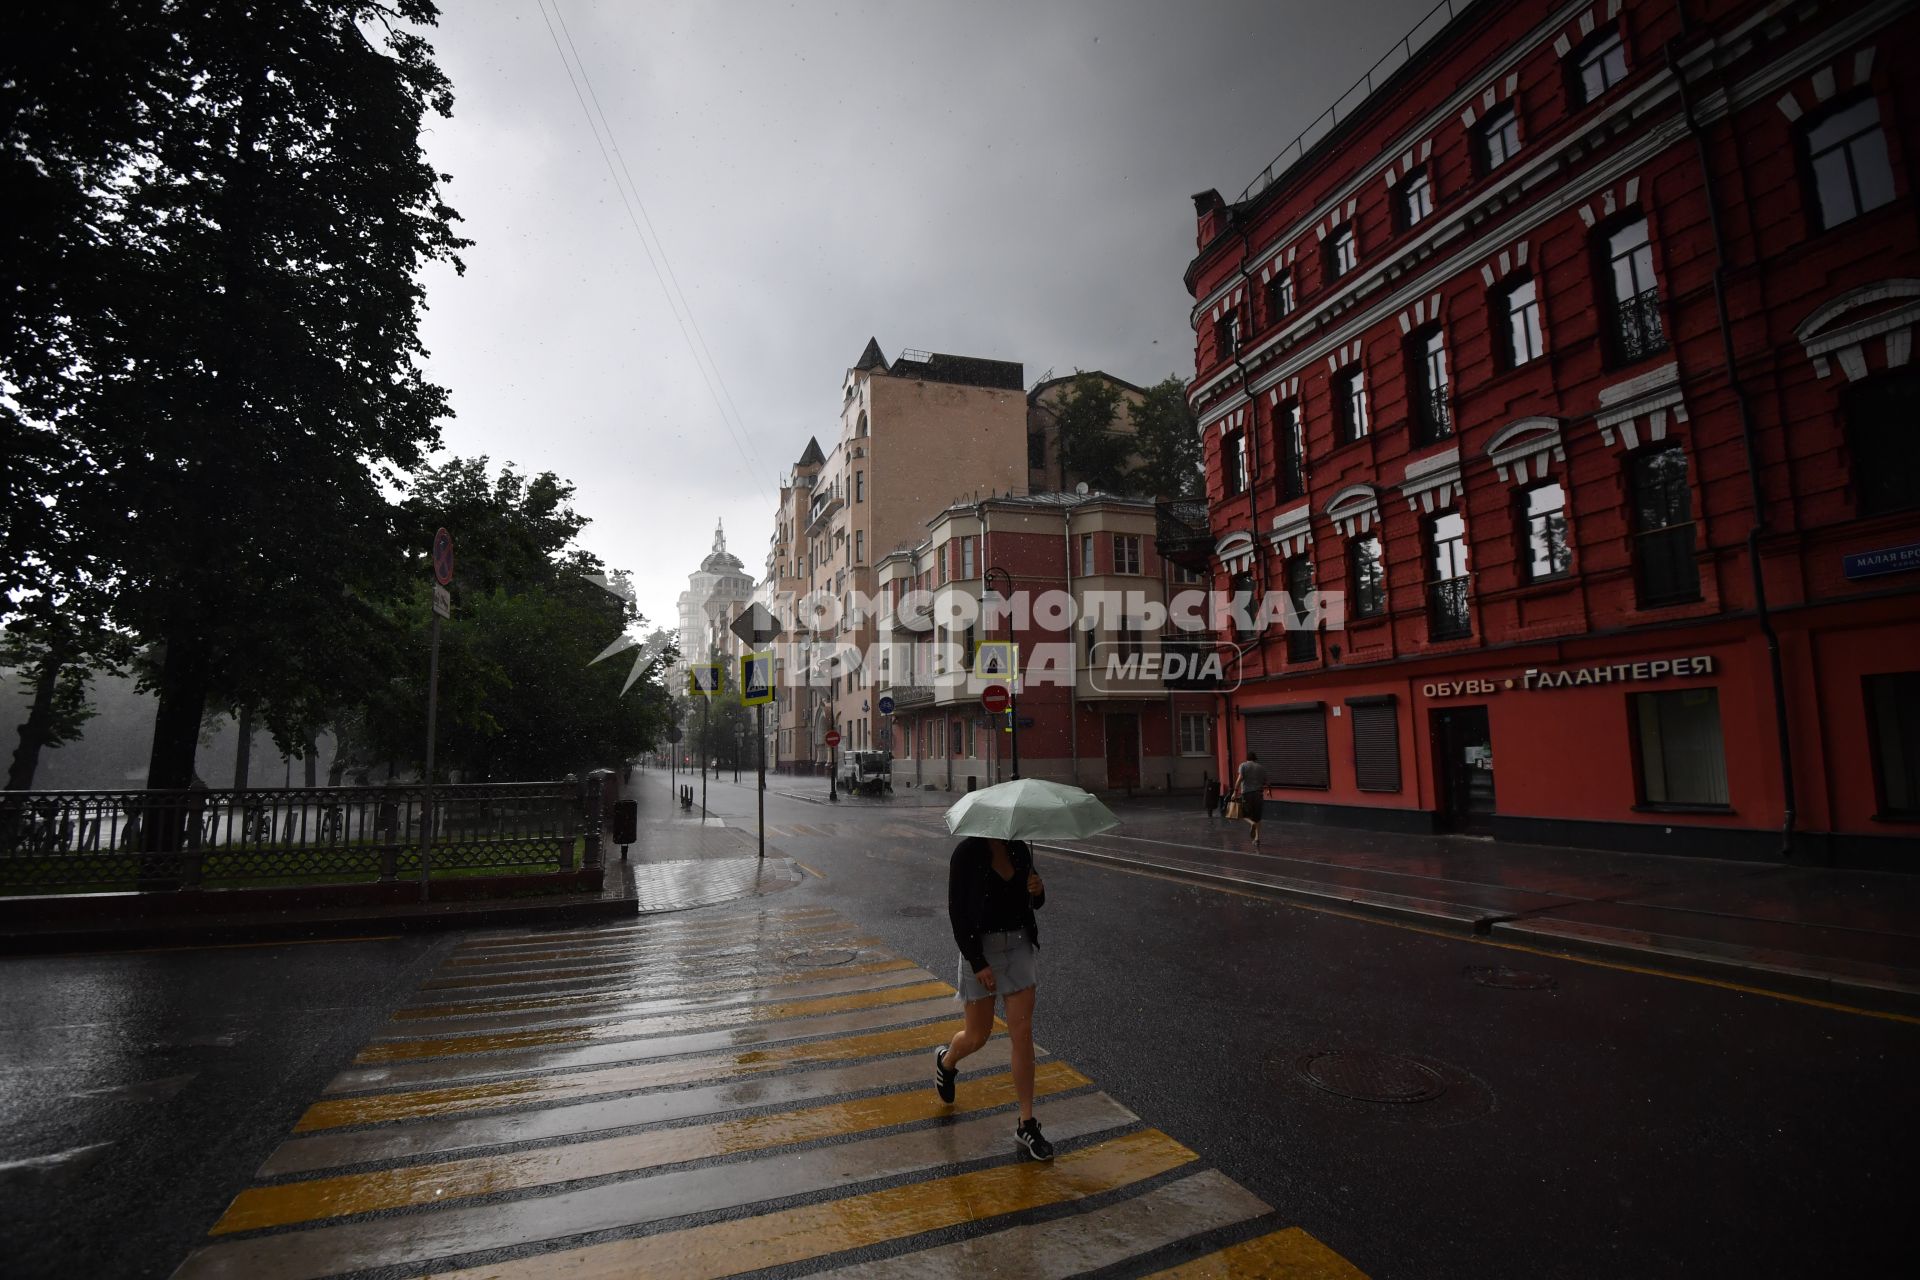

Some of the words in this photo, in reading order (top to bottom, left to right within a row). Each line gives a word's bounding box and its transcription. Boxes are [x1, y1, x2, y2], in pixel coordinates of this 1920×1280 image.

[1857, 552, 1897, 567] МАЛАЯ
[1423, 678, 1495, 699] ОБУВЬ
[1523, 655, 1713, 689] ГАЛАНТЕРЕЯ
